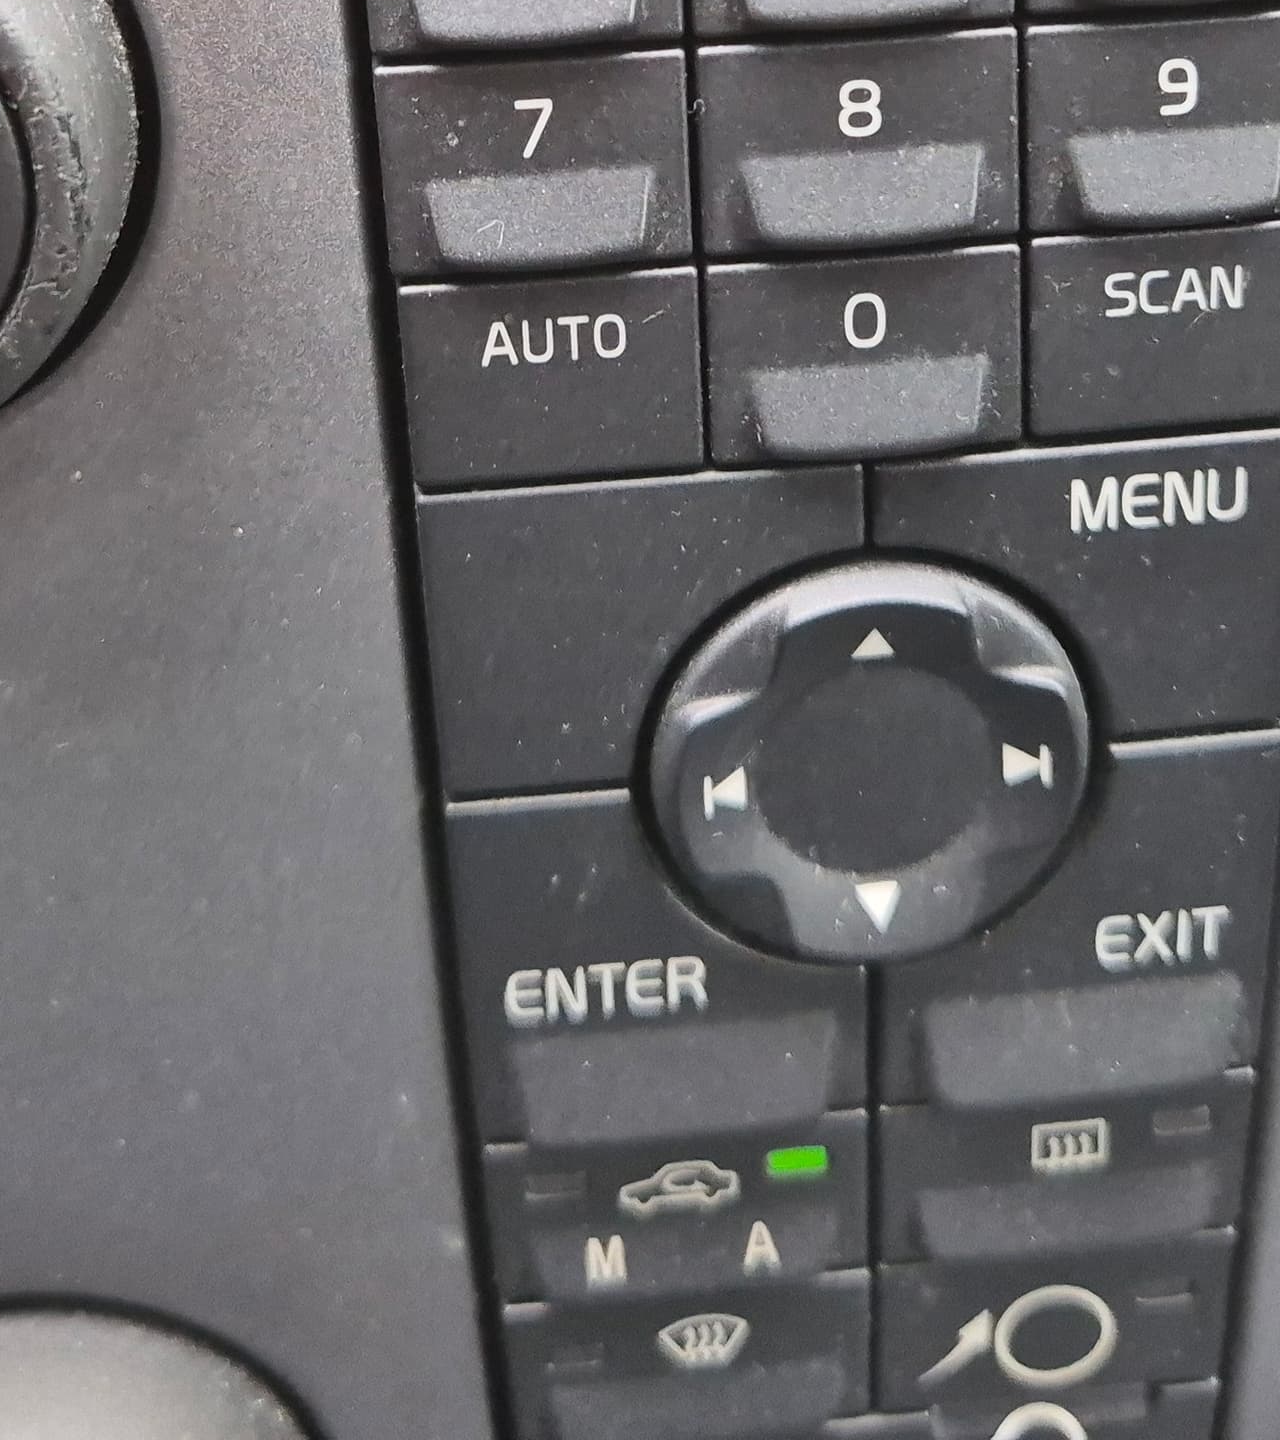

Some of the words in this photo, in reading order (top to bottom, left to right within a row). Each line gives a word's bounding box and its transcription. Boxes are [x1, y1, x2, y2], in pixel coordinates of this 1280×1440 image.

[837, 79, 883, 137] 8
[1157, 58, 1198, 116] 9
[513, 97, 554, 158] 7
[1103, 264, 1245, 318] SCAN
[481, 312, 627, 367] AUTO
[842, 293, 887, 350] 0
[1070, 466, 1248, 534] MENU
[1096, 905, 1231, 968] EXIT
[504, 956, 708, 1022] ENTER
[585, 1235, 627, 1286] M
[743, 1221, 781, 1274] A
